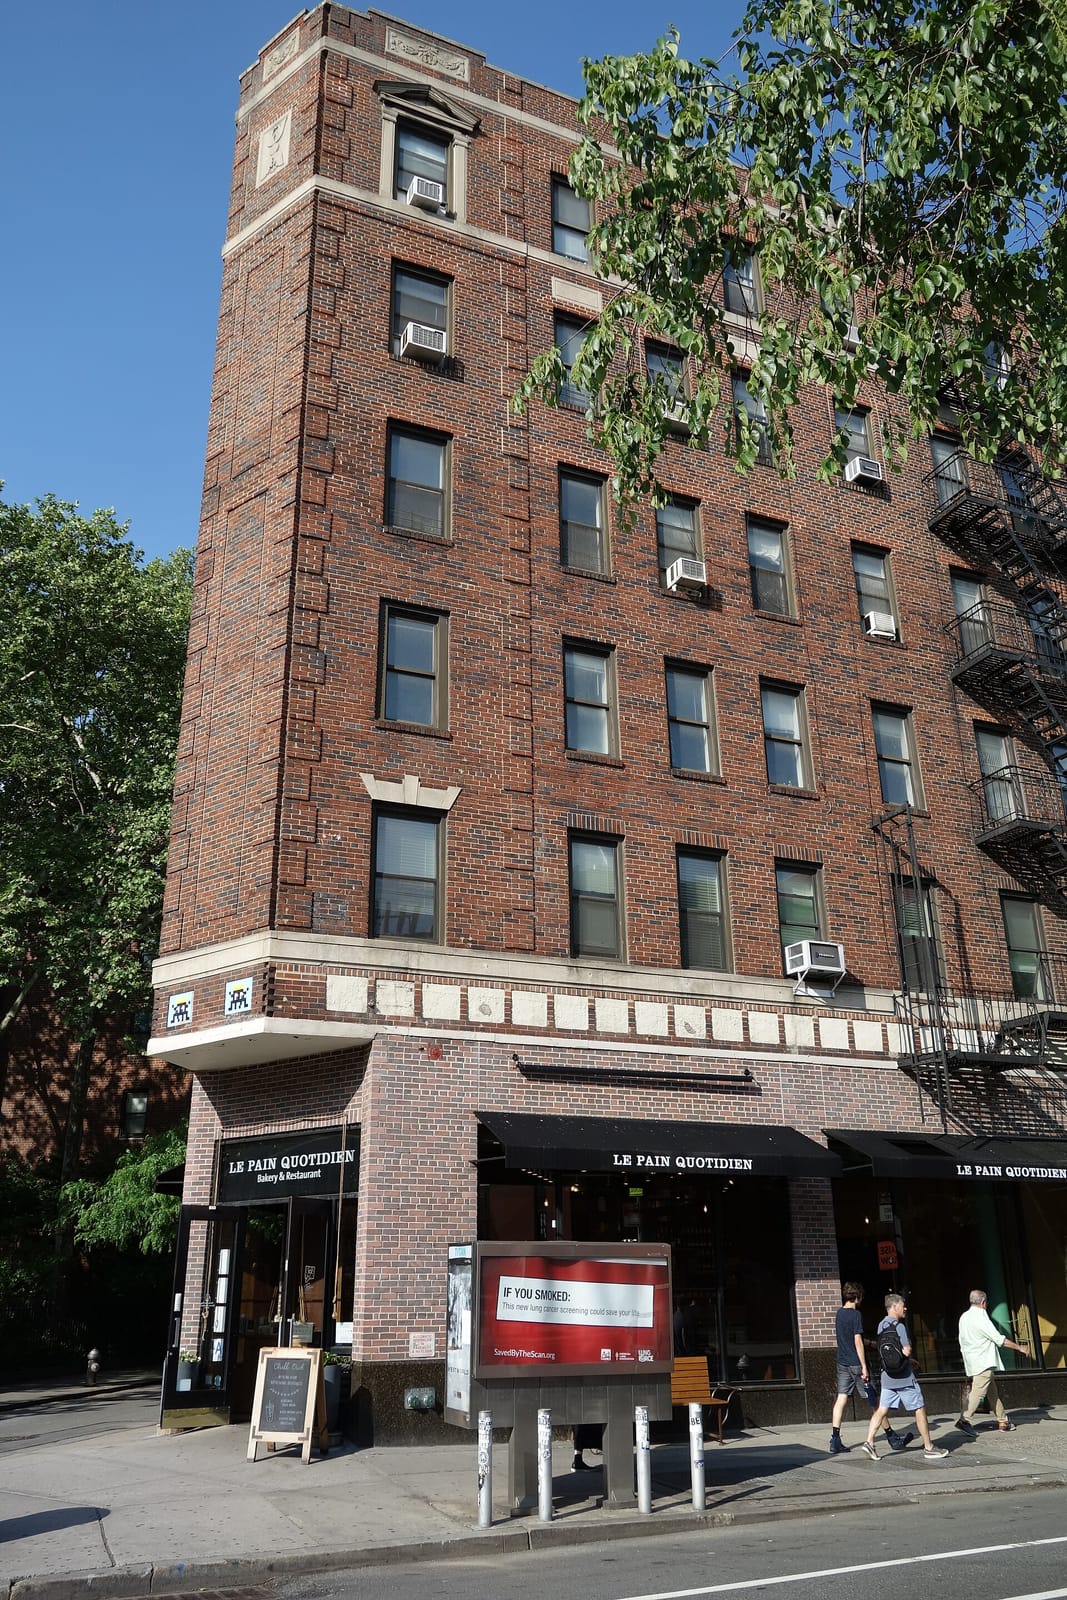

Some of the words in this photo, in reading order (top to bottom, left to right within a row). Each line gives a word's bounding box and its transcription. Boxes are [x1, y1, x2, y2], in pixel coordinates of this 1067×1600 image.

[229, 1161, 244, 1173] LE
[247, 1158, 277, 1171] PAIN
[281, 1150, 355, 1169] QUOTIDIEN
[613, 1154, 632, 1166] LE
[636, 1155, 671, 1167] PAIN
[675, 1156, 753, 1170] QUOTIDIEN
[257, 1173, 279, 1184] Bakery
[279, 1172, 286, 1181] &
[286, 1169, 321, 1180] Restaurant
[956, 1165, 973, 1176] LE
[974, 1165, 1002, 1176] PAIN
[1005, 1166, 1067, 1179] QUOTIDIEN
[503, 1287, 512, 1298] IF
[514, 1288, 533, 1300] YOU
[534, 1289, 571, 1302] SMOKED:
[502, 1302, 515, 1310] This
[530, 1304, 543, 1313] lung
[559, 1306, 588, 1315] screening
[589, 1308, 604, 1316] could
[618, 1310, 631, 1318] your
[494, 1348, 555, 1360] SavedByTheScan.org
